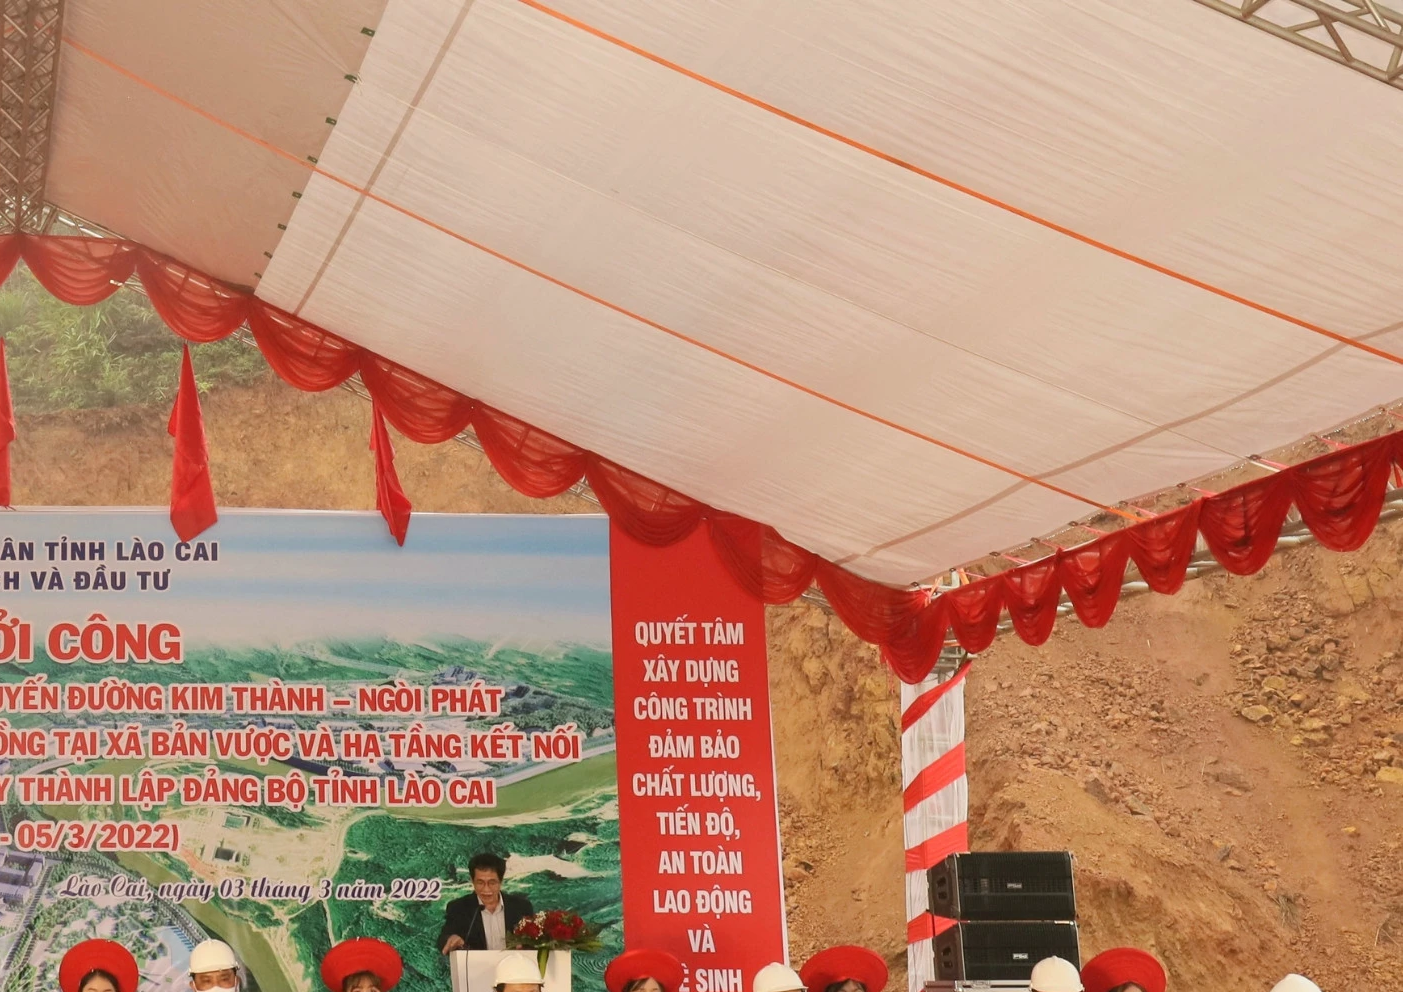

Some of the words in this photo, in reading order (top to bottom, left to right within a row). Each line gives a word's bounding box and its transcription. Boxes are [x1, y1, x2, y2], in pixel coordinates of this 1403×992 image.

[45, 535, 105, 562] TỈNH
[116, 535, 165, 562] LÀO
[175, 541, 219, 562] CAI
[31, 566, 65, 592] VÀ
[73, 564, 126, 592] ĐẦU
[136, 568, 172, 592] TƯ
[47, 613, 182, 660] CÔNG
[635, 614, 697, 648] QUYẾT
[701, 617, 744, 645] TÂM
[643, 654, 680, 682] XÂY
[686, 656, 739, 688] DỰNG
[67, 678, 163, 712] ĐƯỜNG
[172, 686, 222, 712] KIM
[231, 680, 324, 712] THÀNH
[358, 680, 422, 712] NGÒI
[431, 680, 501, 713] PHÁT
[633, 691, 688, 720] CÔNG
[693, 692, 752, 721] TRÌNH
[53, 731, 97, 761] TẠI
[105, 725, 142, 757] XÃ
[150, 721, 207, 757] BẢN
[215, 729, 290, 763] VƯỢC
[298, 726, 335, 757] VÀ
[343, 733, 380, 763] HẠ
[388, 722, 465, 759] TẦNG
[471, 722, 525, 759] KẾT
[534, 721, 580, 759] NỐI
[648, 728, 694, 758] ĐẢM
[700, 728, 740, 758] BẢO
[18, 771, 112, 803] THÀNH
[121, 771, 175, 810] LẬP
[182, 767, 257, 803] ĐẢNG
[267, 771, 305, 811] BỘ
[312, 768, 379, 804] TỈNH
[387, 771, 440, 804] LÀO
[449, 778, 494, 805] CAI
[632, 765, 684, 797] CHẤT
[690, 771, 761, 802] LƯỢNG,
[656, 804, 701, 835] TIẾN
[705, 807, 741, 841] ĐỘ,
[658, 850, 685, 874] AN
[690, 845, 743, 875] TOÀN
[59, 876, 101, 897] Lào
[109, 875, 153, 900] Cai,
[158, 878, 211, 901] ngày
[219, 877, 245, 898] 03
[250, 877, 310, 901] tháng
[318, 878, 330, 898] 3
[337, 878, 384, 899] năm
[390, 879, 440, 900] 2022
[653, 889, 690, 913] LAO
[695, 884, 752, 919] ĐỘNG
[687, 923, 716, 953] VÀ
[695, 968, 743, 992] SINH
